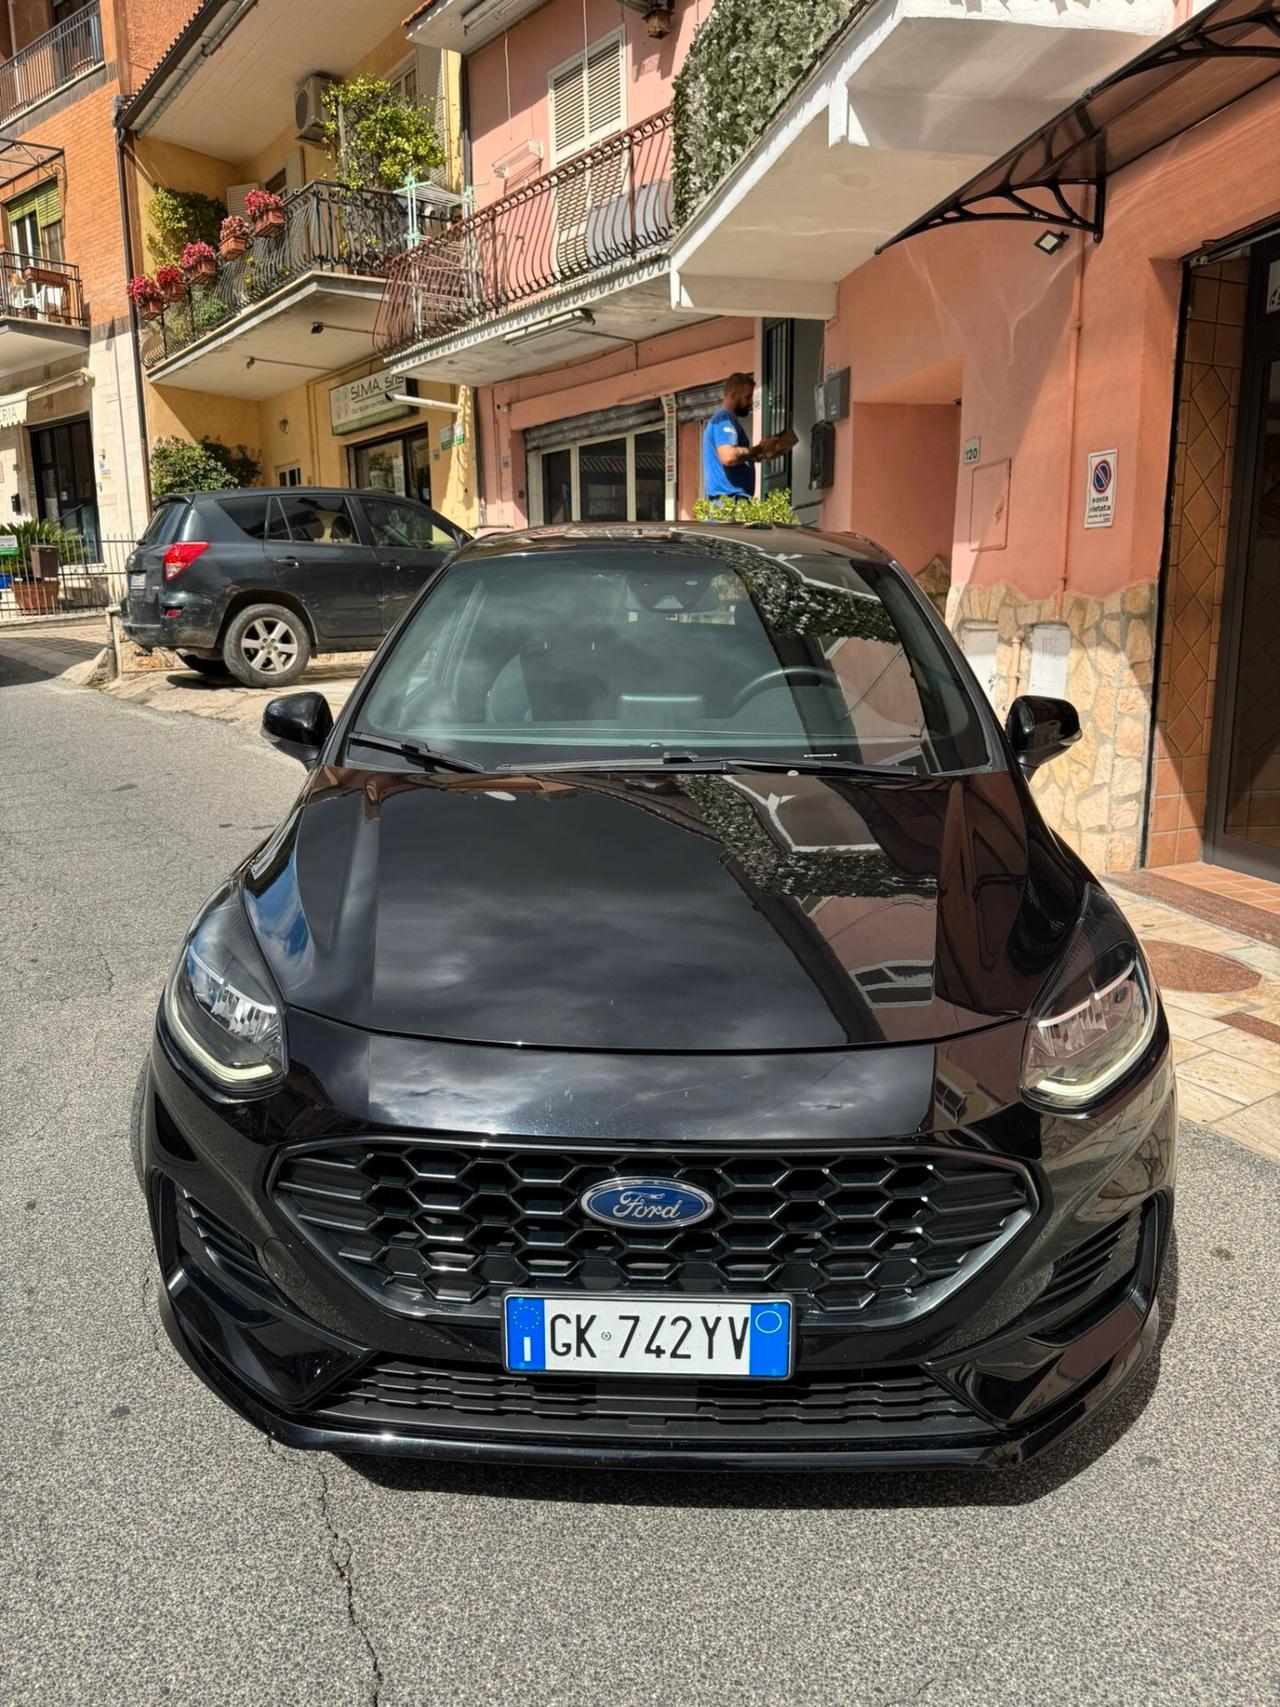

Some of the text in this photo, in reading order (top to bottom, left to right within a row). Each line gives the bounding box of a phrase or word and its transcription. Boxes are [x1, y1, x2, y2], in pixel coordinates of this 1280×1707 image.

[0, 406, 18, 424] RIA
[612, 1191, 683, 1219] Ford
[549, 1313, 750, 1360] GK 742YV
